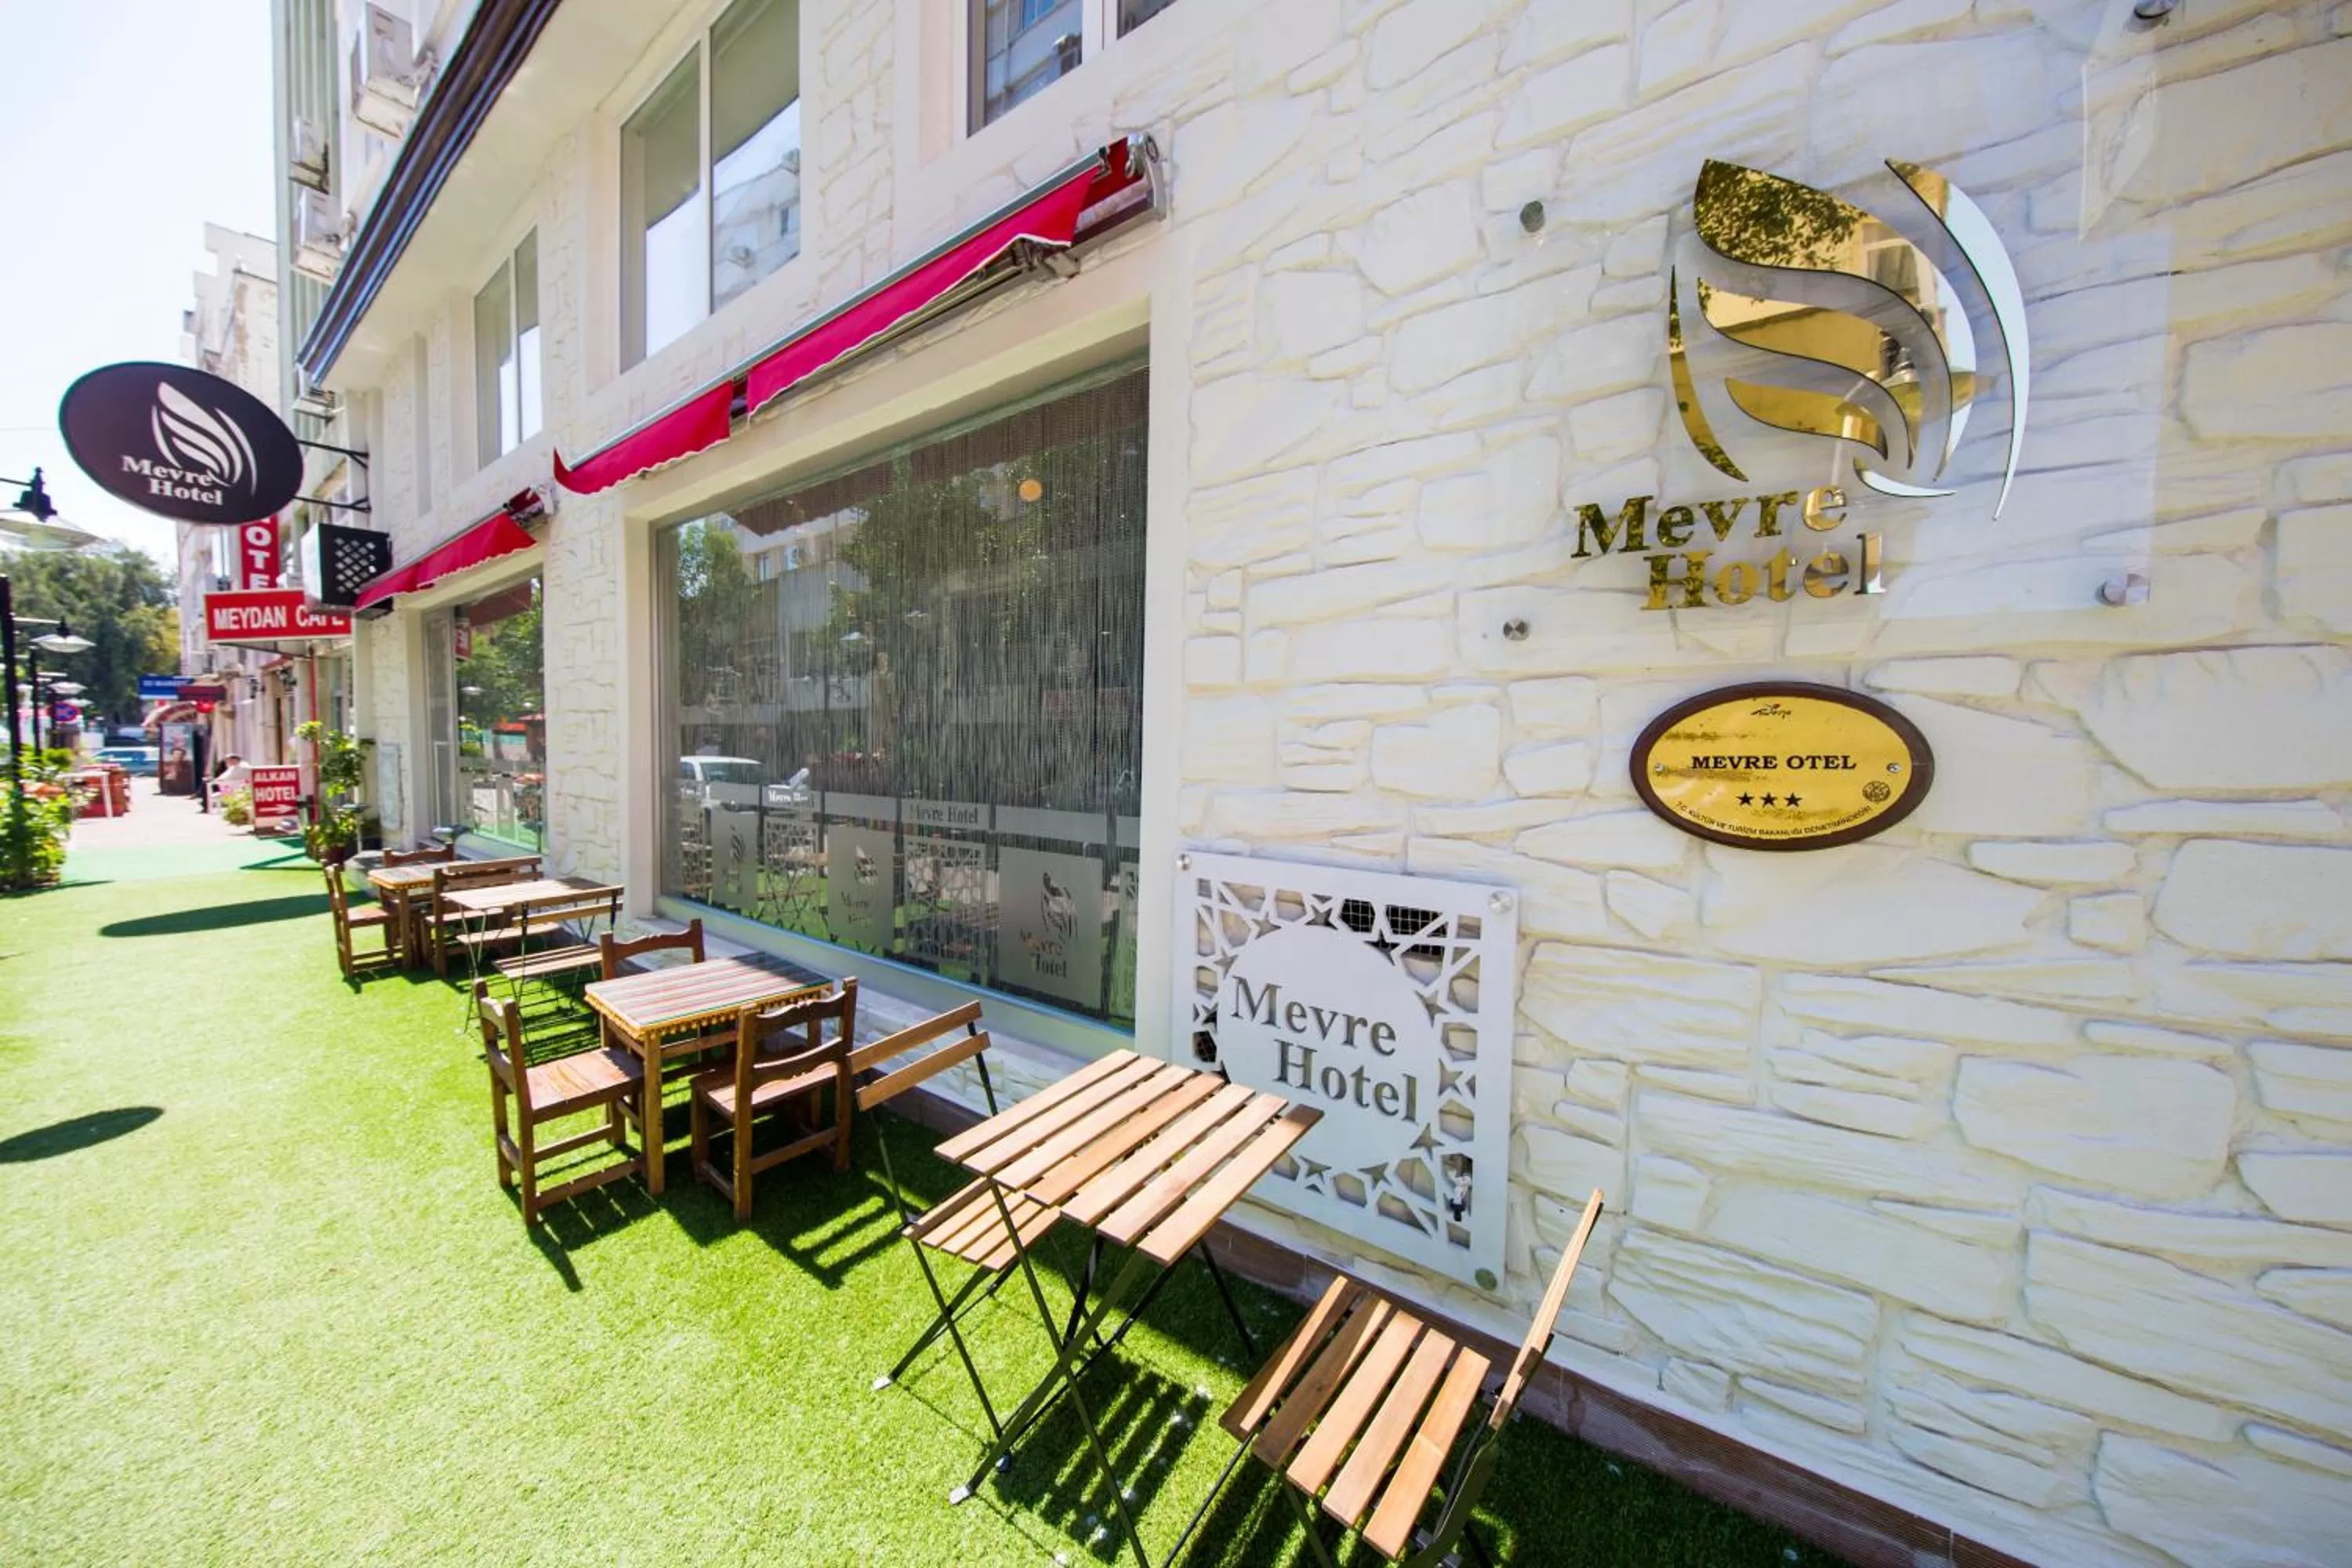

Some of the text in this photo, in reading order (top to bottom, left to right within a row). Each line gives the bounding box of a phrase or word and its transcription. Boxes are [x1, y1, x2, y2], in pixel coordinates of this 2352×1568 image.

[120, 455, 214, 486] Mevre
[149, 477, 223, 506] Hotel
[1570, 485, 1848, 559] Mevre
[245, 517, 271, 590] OTE
[1640, 532, 1886, 610] Hotel
[213, 605, 286, 630] MEYDAN
[254, 771, 296, 782] ALKAN
[1691, 754, 1857, 770] MEVRE OTEL
[255, 786, 296, 802] HOTEL
[948, 805, 979, 825] Hotel
[1230, 975, 1396, 1056] Mevre
[1273, 1039, 1419, 1126] Hotel
